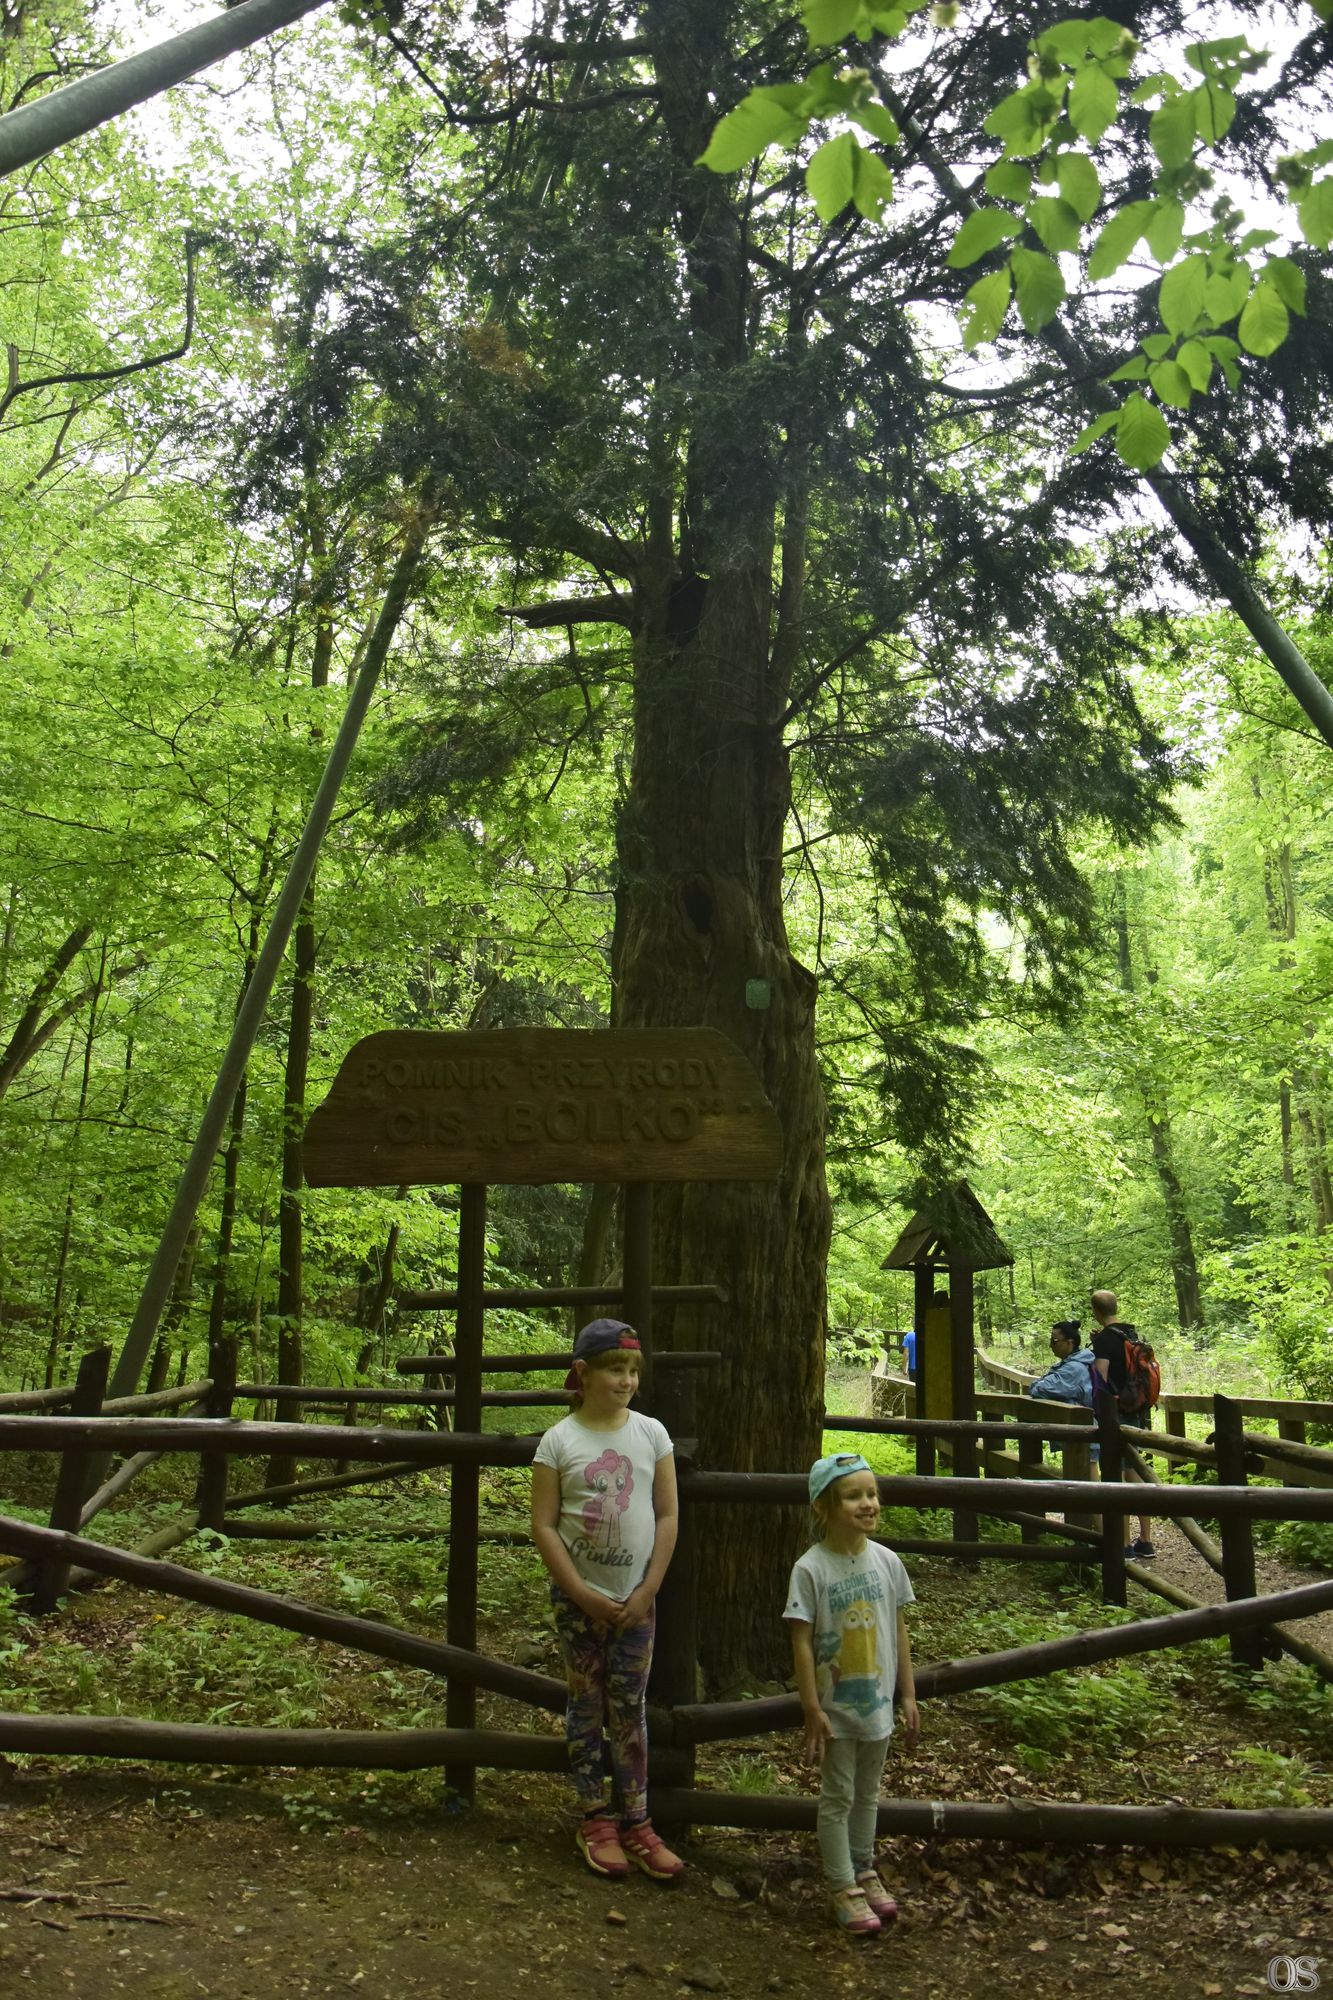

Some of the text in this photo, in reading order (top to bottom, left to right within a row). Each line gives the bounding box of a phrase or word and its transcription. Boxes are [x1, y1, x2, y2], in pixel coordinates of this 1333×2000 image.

[360, 1059, 509, 1090] POMNIK
[386, 1106, 464, 1146] CIS
[570, 1537, 634, 1567] Pinkie
[827, 1569, 880, 1597] WELCOME TO
